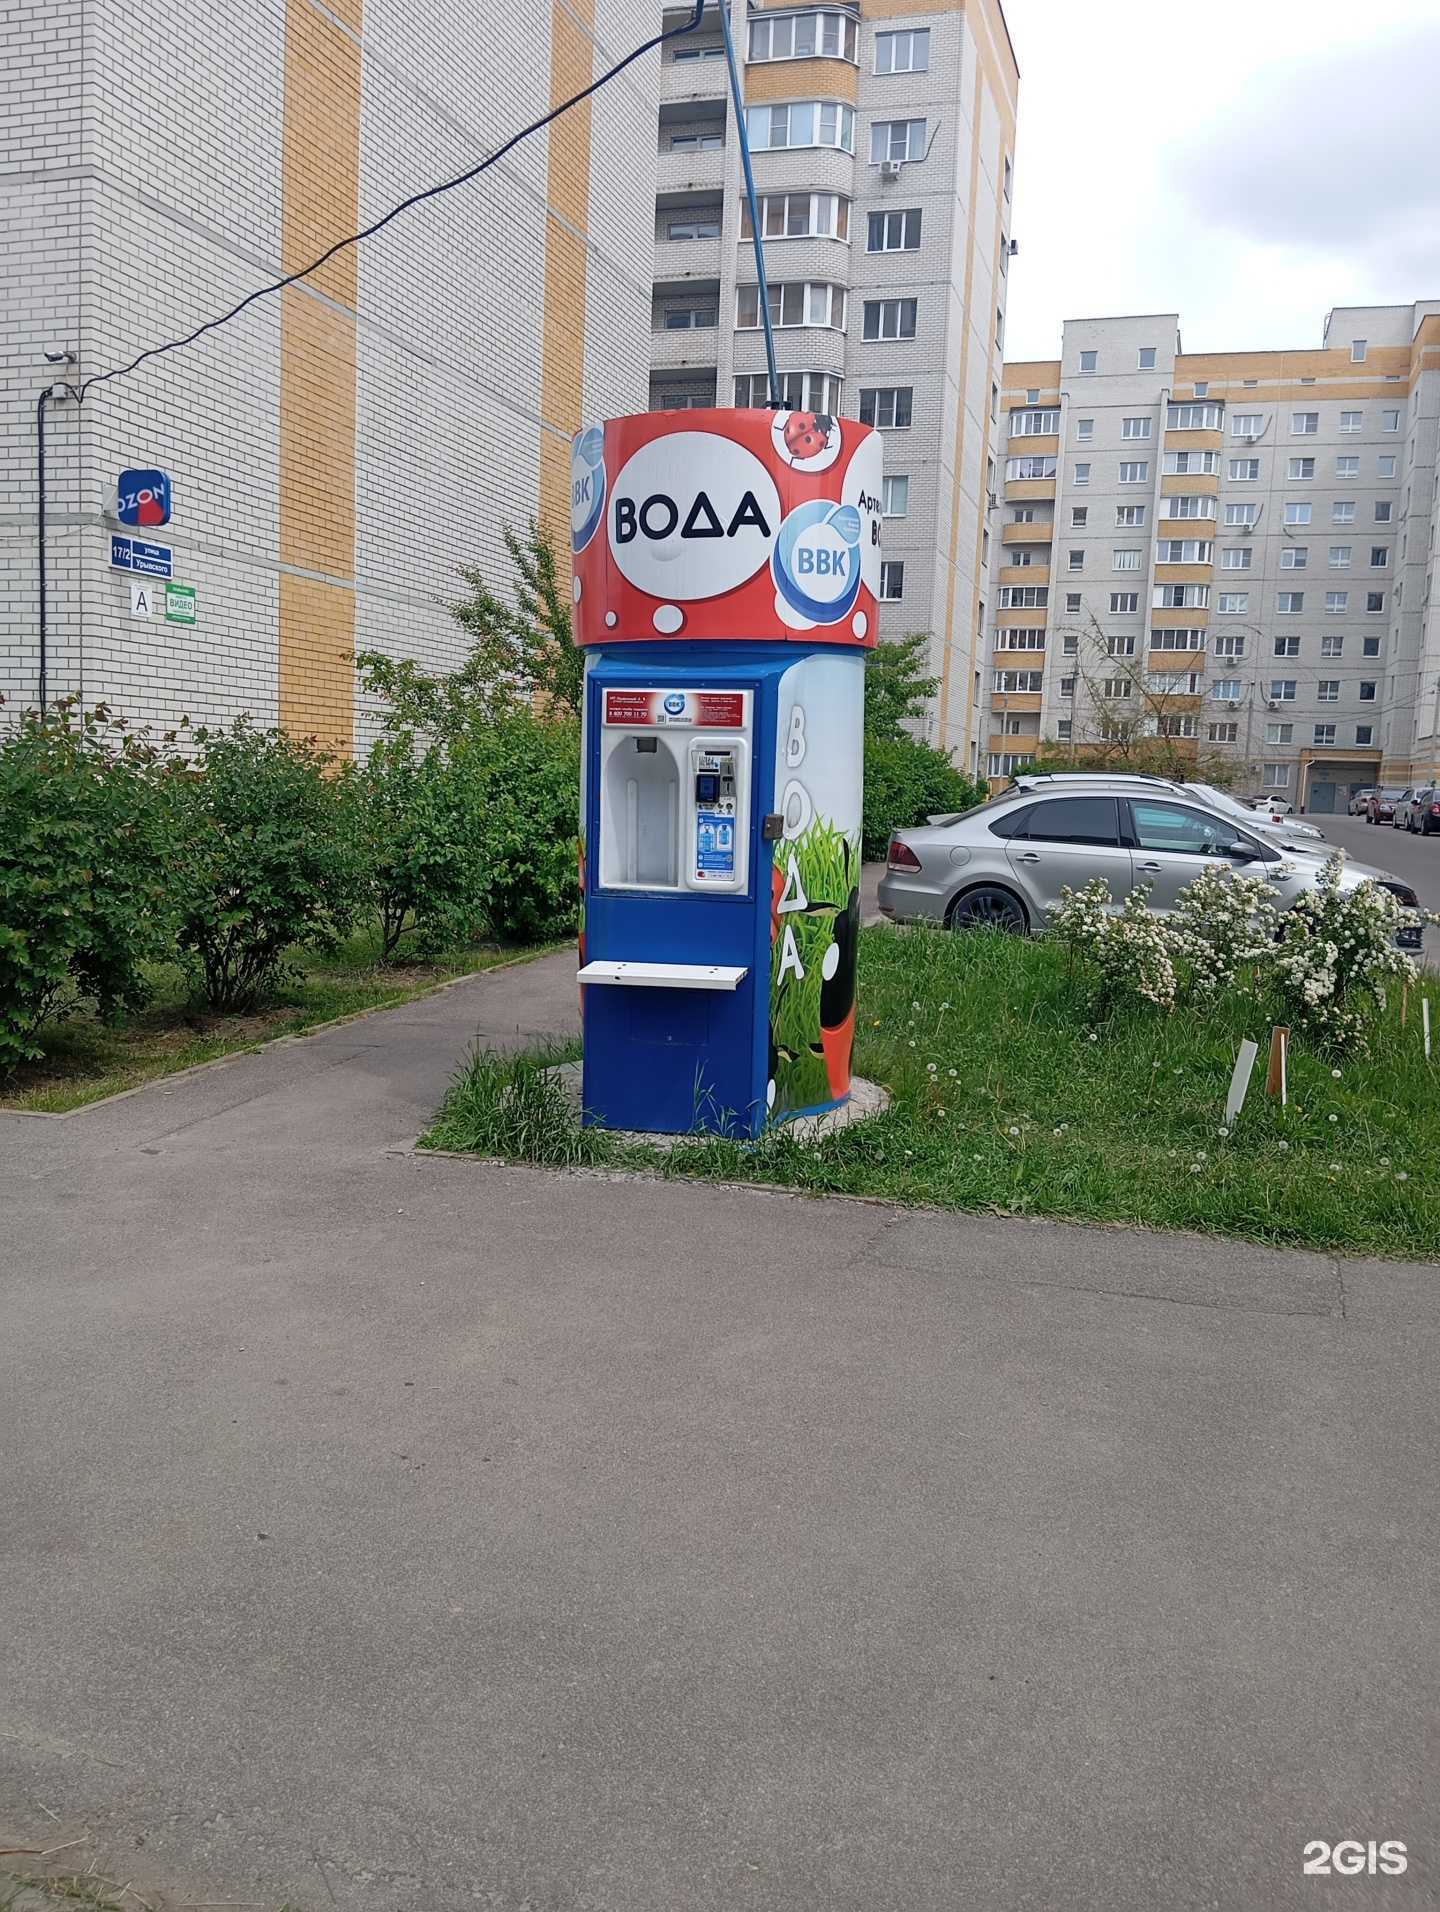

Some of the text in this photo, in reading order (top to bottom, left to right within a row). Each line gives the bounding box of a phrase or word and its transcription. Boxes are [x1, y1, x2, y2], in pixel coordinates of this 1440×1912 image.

[572, 476, 590, 509] ВК
[858, 489, 882, 515] Арте
[615, 490, 771, 544] ВОДА
[112, 545, 131, 561] 17/2
[136, 559, 169, 574] Урывского
[798, 548, 846, 577] ВВК
[169, 598, 193, 610] ВИДЕО
[777, 704, 813, 986] ВОДА
